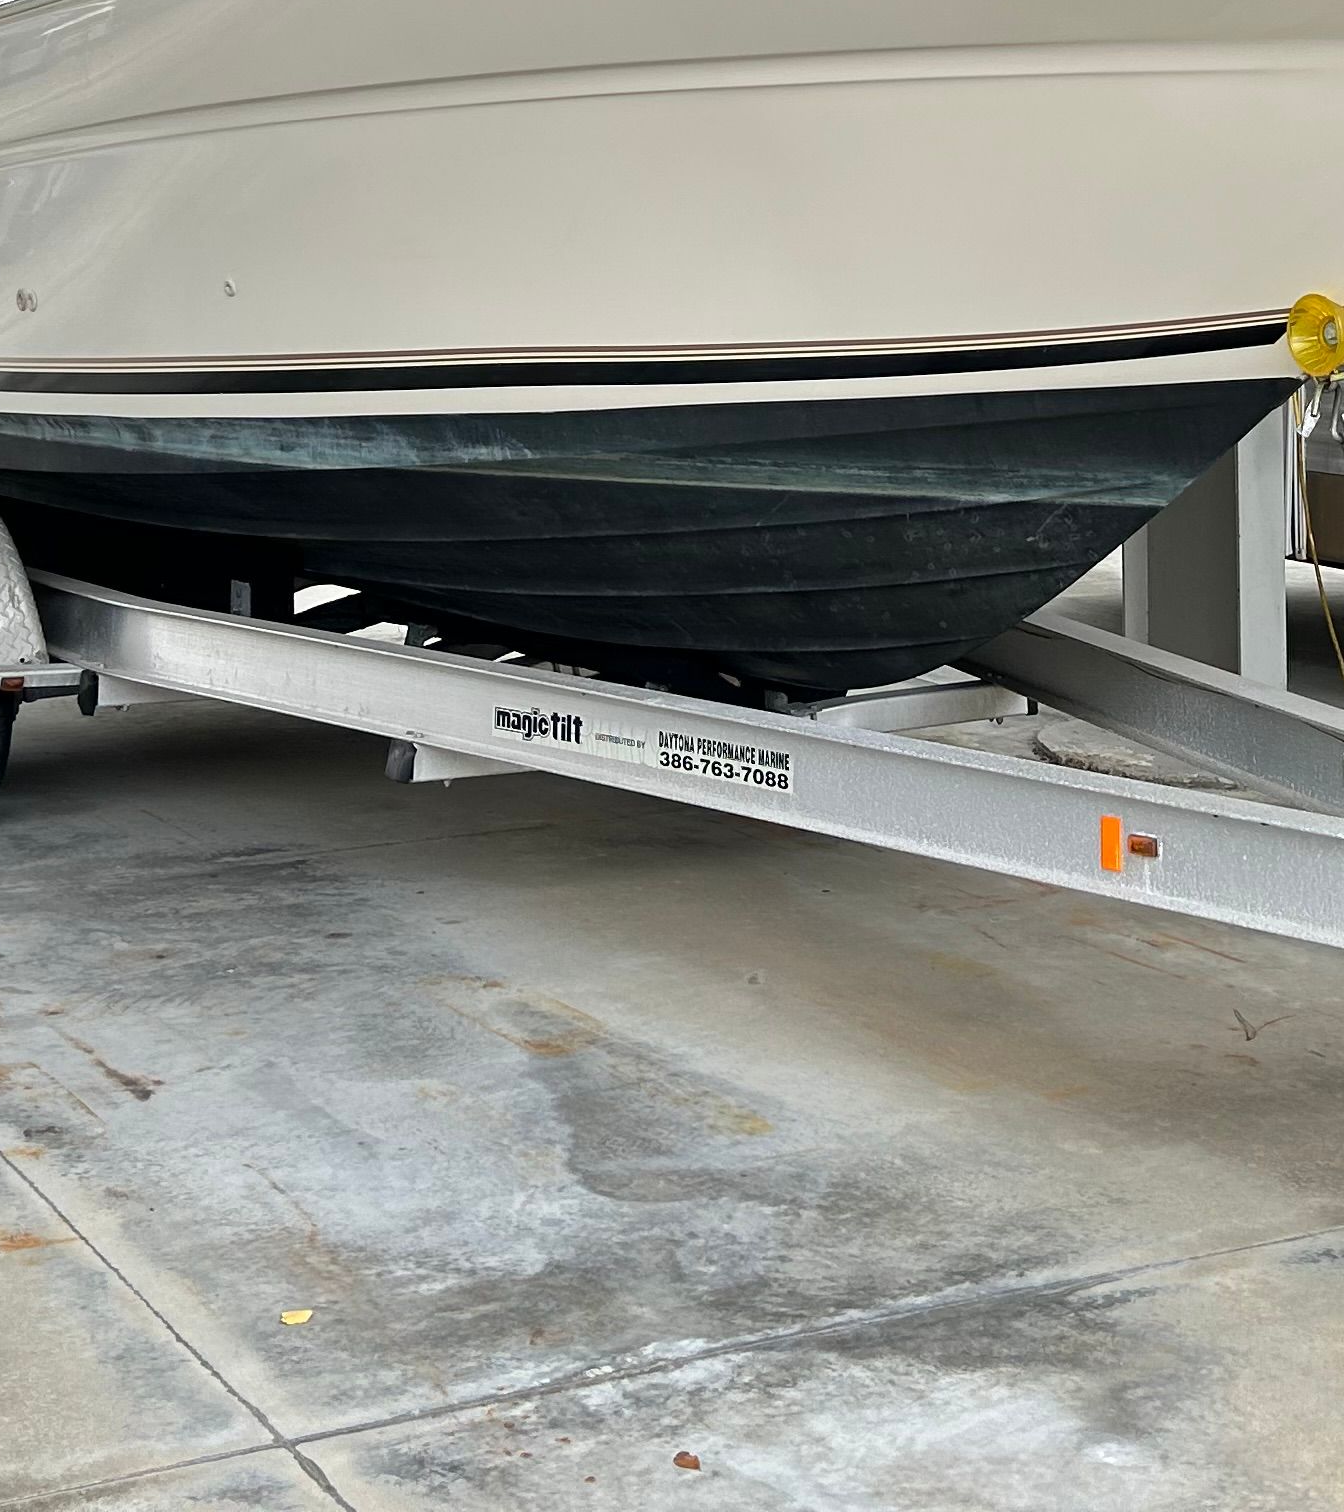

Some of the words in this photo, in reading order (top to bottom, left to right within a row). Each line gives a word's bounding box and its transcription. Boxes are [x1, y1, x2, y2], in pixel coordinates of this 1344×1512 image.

[595, 733, 635, 747] DISTRIBUTED
[636, 741, 646, 749] BY
[659, 731, 695, 753] DAYTONA
[697, 738, 756, 764] PERFORMANCE
[758, 748, 789, 771] MARINE
[659, 751, 789, 789] 386-763-7088
